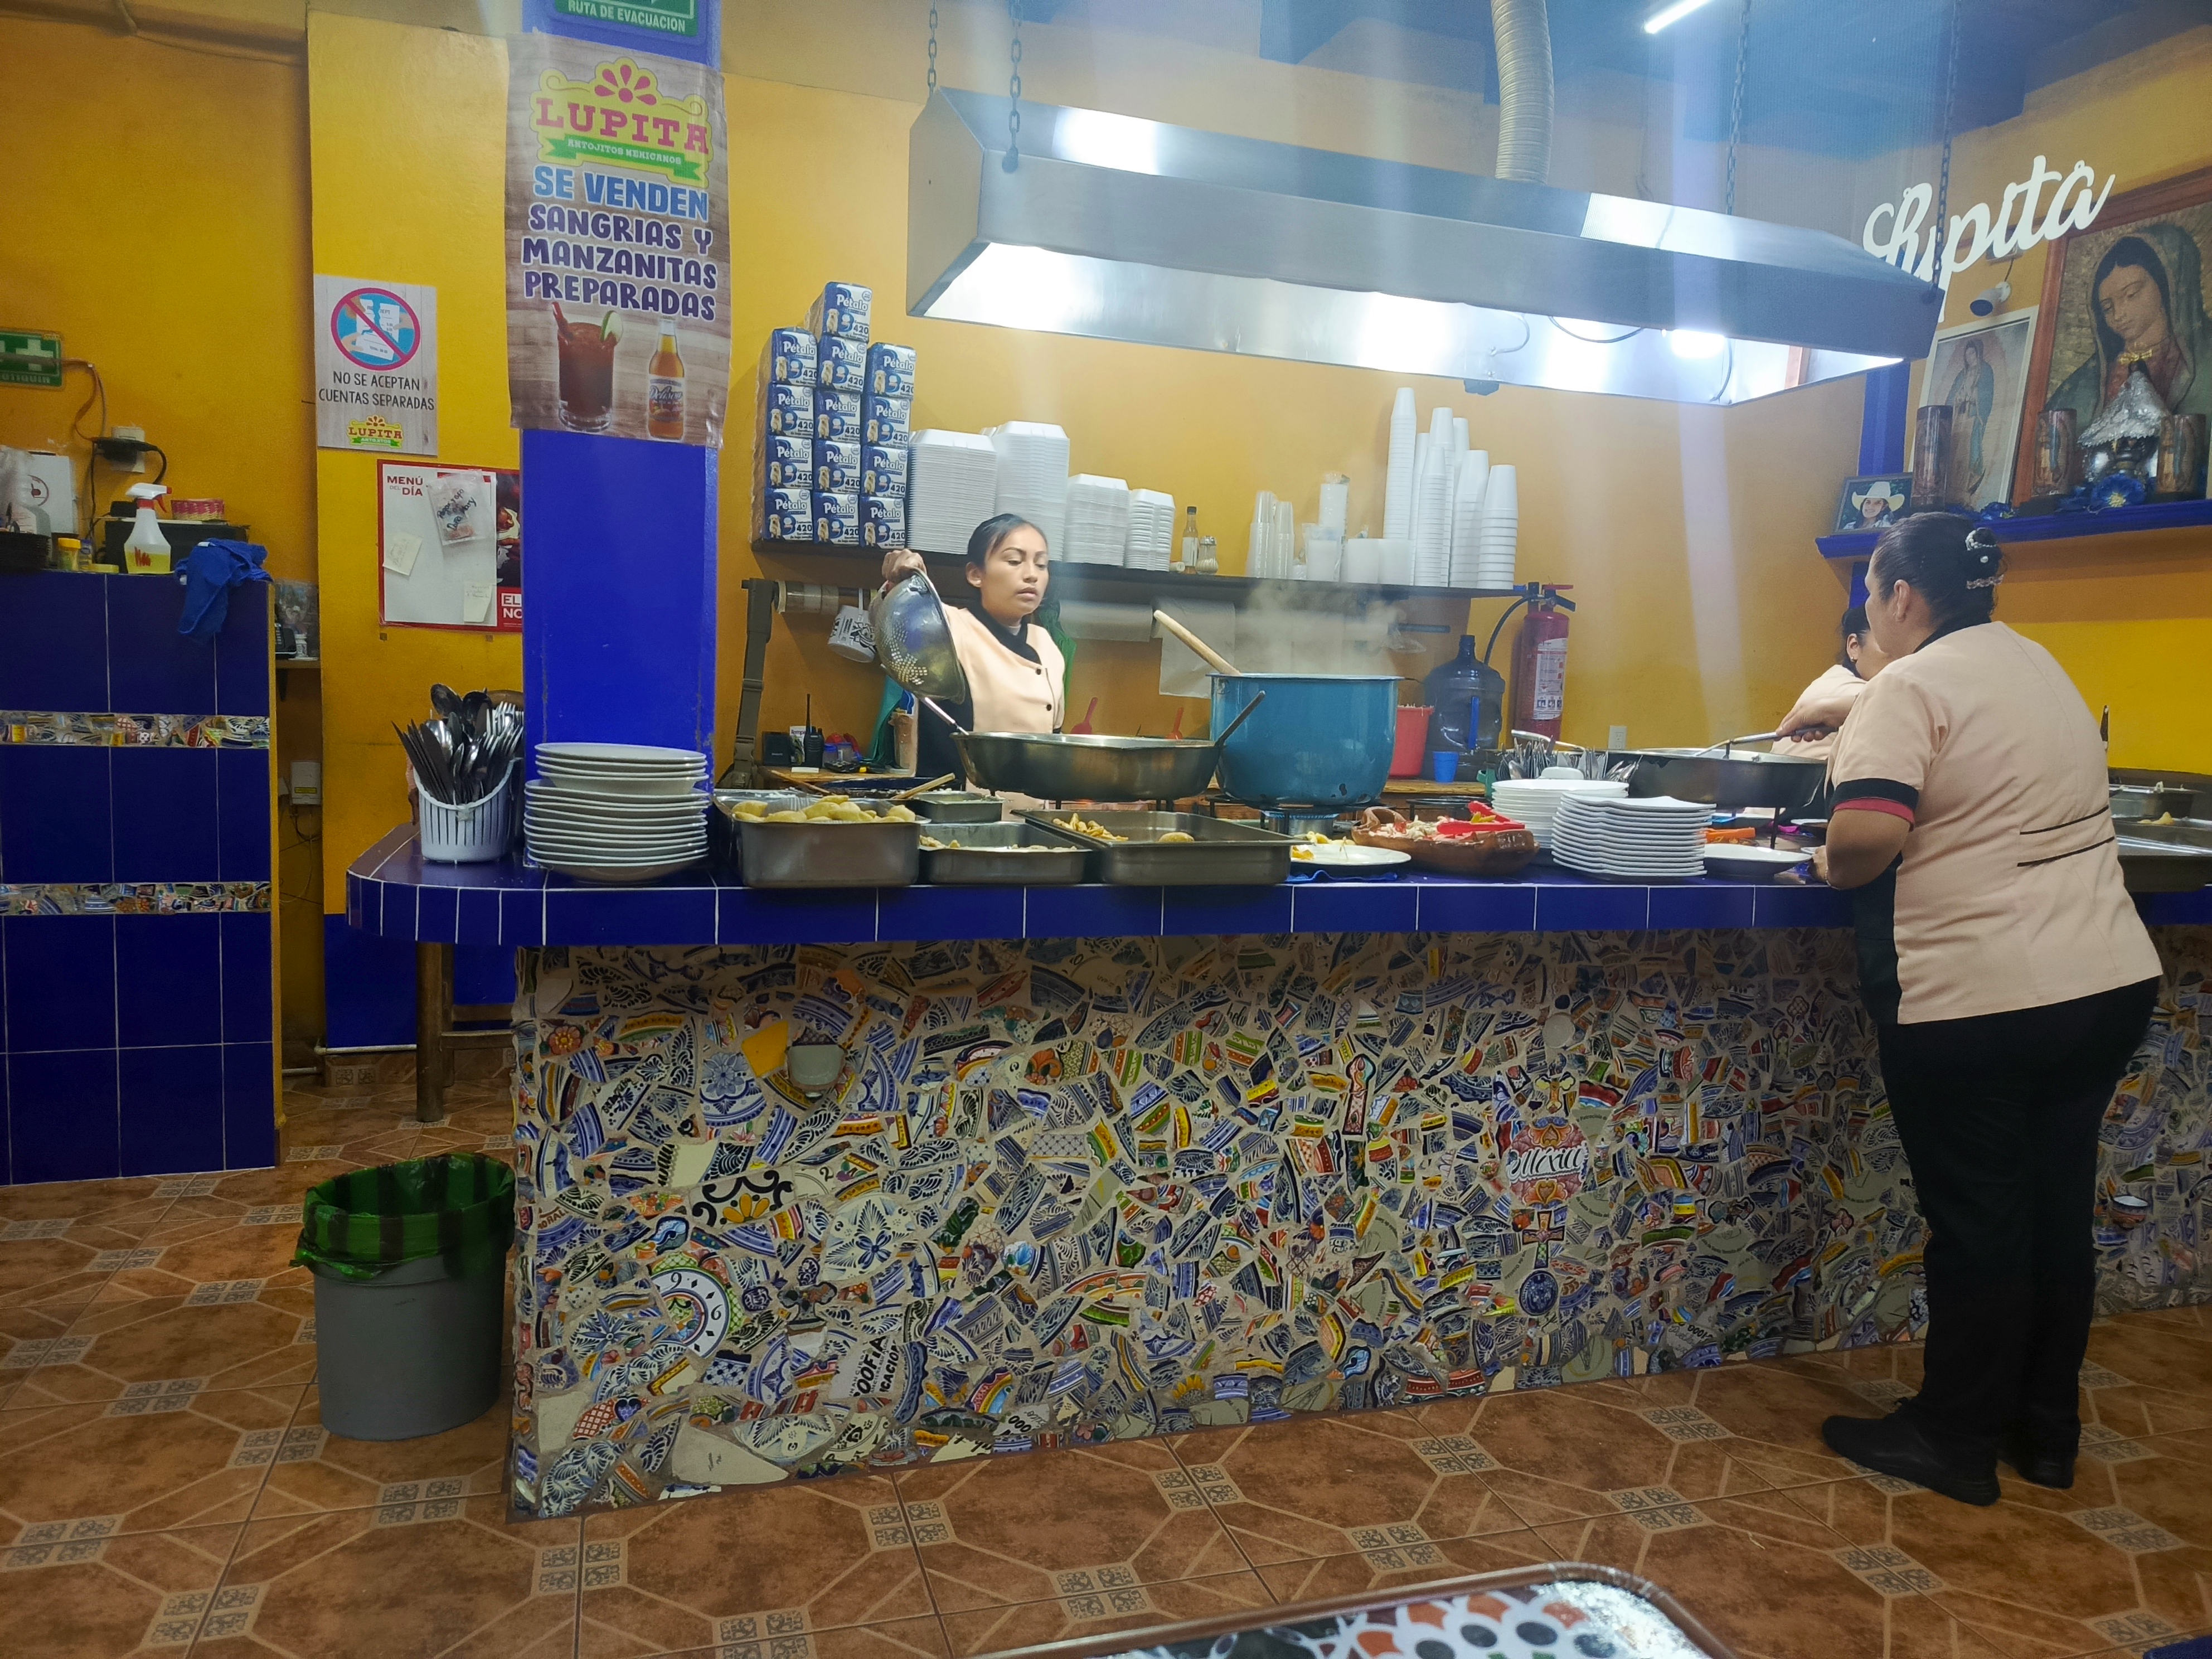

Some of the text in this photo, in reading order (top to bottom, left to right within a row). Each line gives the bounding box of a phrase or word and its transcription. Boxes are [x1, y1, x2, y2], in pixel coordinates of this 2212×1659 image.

[568, 0, 686, 33] RUTA DE EVACUACION
[536, 98, 709, 154] LUPITA
[567, 138, 681, 165] ANTOJITOS MEXICANOS
[534, 166, 708, 221] SE VENDEN
[530, 205, 712, 255] SANGRIAS Y
[523, 238, 717, 289] MANZANITAS
[525, 271, 715, 321] PREPARADAS
[837, 294, 868, 311] Pétalo
[854, 324, 869, 334] 420
[783, 341, 815, 355] Pétalo
[832, 346, 863, 362] Pétalo
[884, 356, 914, 371] Pétalo
[333, 371, 420, 391] NO SE ACEPTAN
[848, 377, 864, 386] 420
[319, 389, 435, 411] CUENTAS SEPARADAS
[778, 394, 809, 406] Pétalo
[825, 399, 857, 413] Pétalo
[876, 405, 906, 419] Pétalo
[348, 426, 402, 439] LUPITA
[893, 433, 908, 442] 420
[777, 446, 808, 459] Pétalo
[826, 452, 857, 465] Pétalo
[874, 456, 904, 471] Pétalo
[387, 475, 423, 486] MENÚ
[402, 487, 423, 496] DÍA
[891, 484, 905, 493] 420
[775, 499, 807, 511] Pétalo
[824, 503, 855, 515] Pétalo
[871, 507, 901, 519] Pétalo
[797, 524, 812, 532] 420
[503, 595, 521, 605] EL
